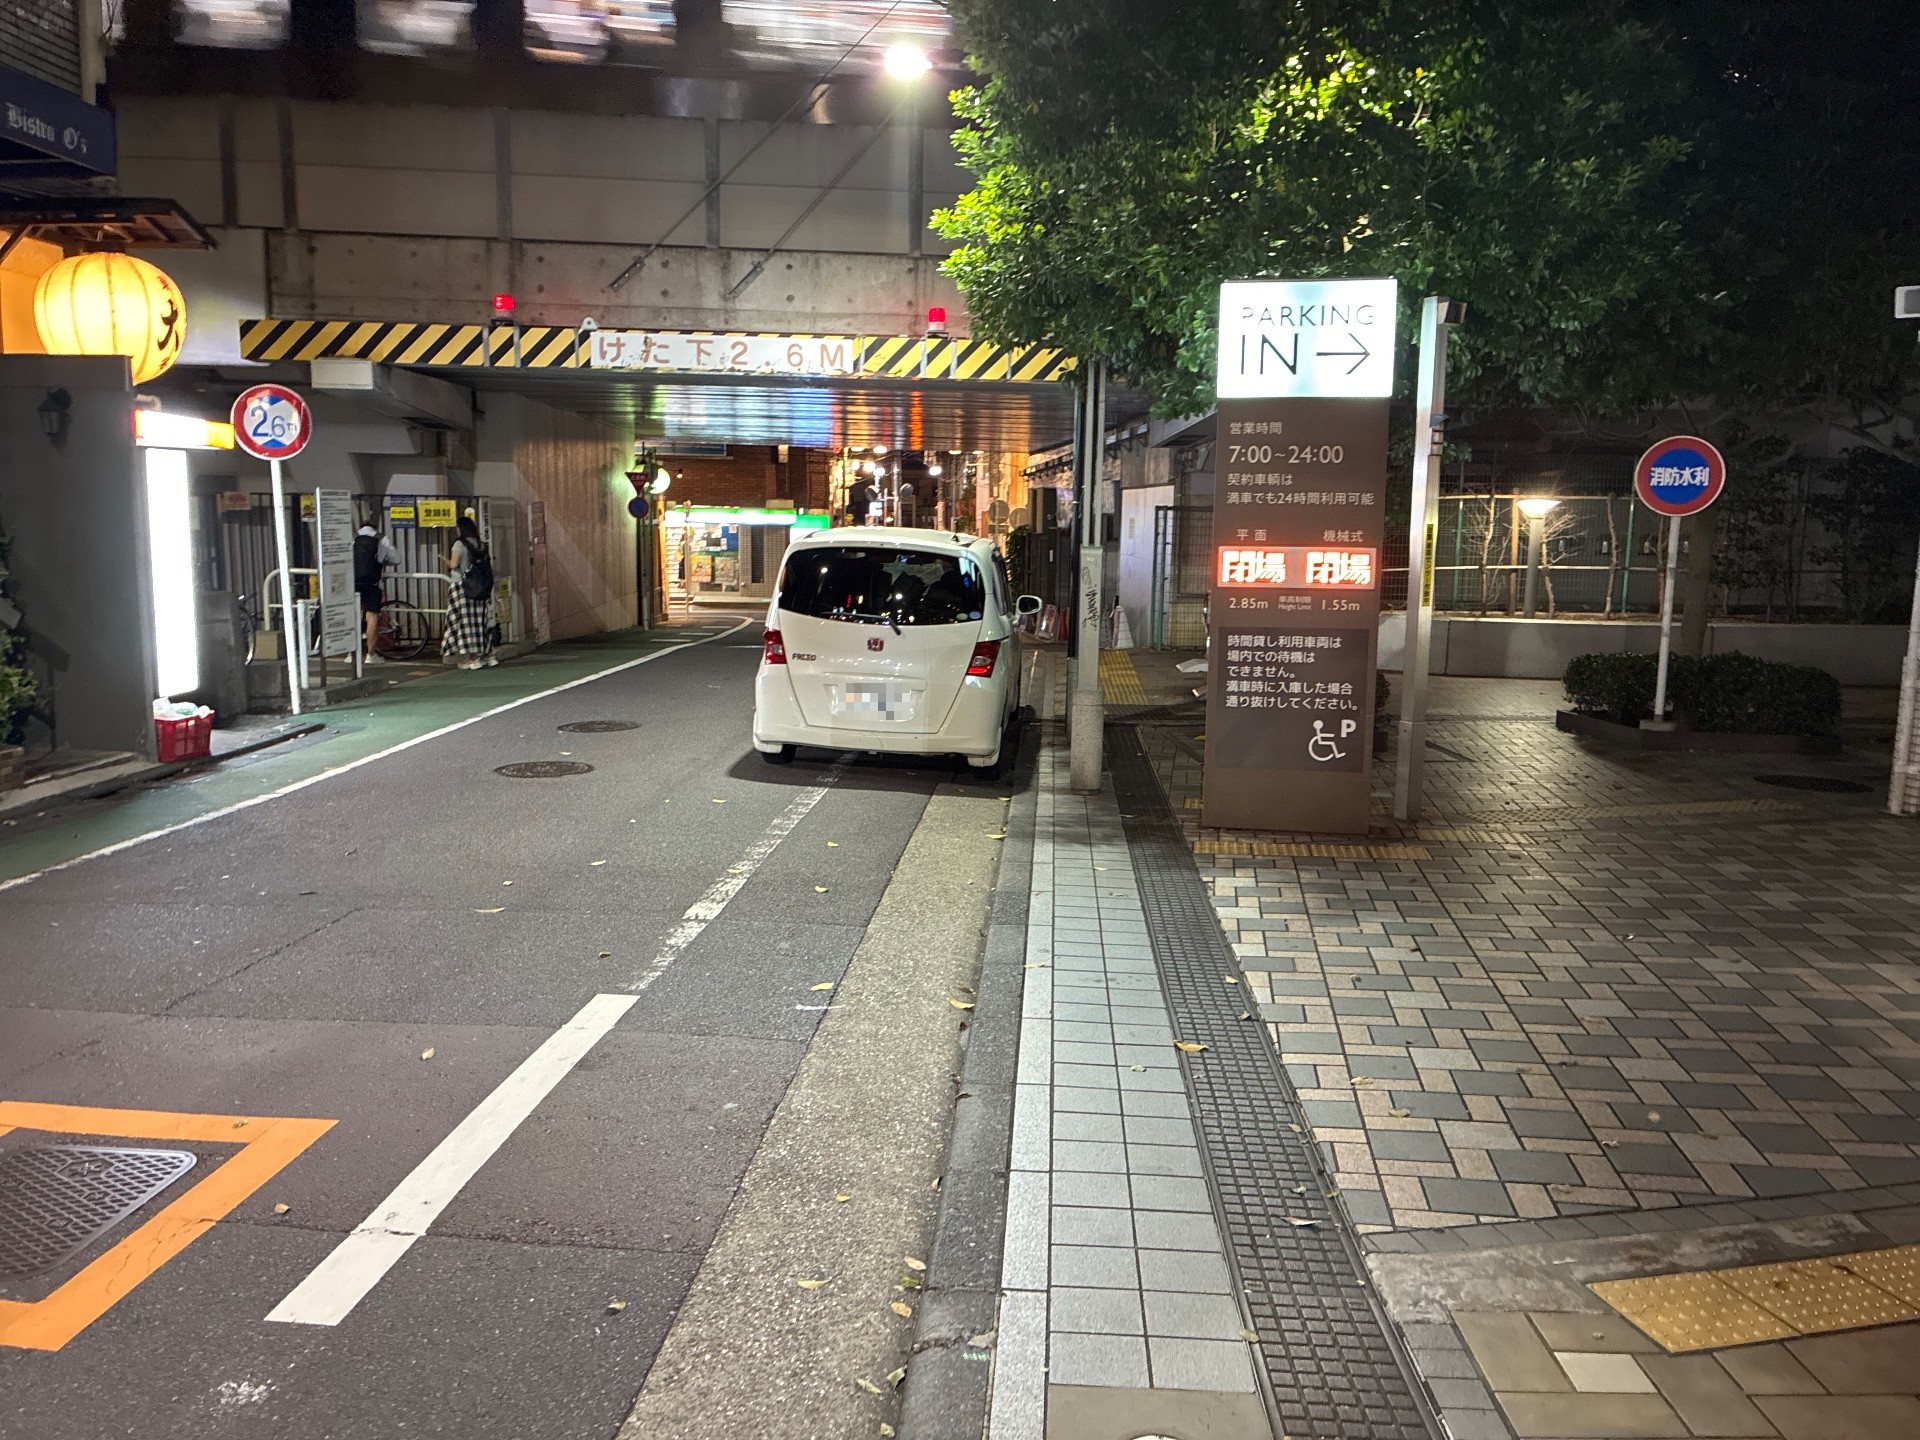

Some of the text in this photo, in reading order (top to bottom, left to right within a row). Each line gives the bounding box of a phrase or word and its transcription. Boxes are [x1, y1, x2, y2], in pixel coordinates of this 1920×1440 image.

[5, 102, 55, 142] Bistro
[1242, 305, 1374, 326] PARKING
[1241, 333, 1299, 375] IN
[1229, 421, 1283, 435] 営業時間
[1650, 466, 1710, 487] 消防水利
[1226, 491, 1375, 506] 満車でも24時間利用可能
[1323, 529, 1364, 543] 機械式
[1222, 550, 1371, 585] 閉場 閉場
[1229, 597, 1269, 609] 2.85m
[1321, 599, 1360, 611] 1.55m
[1227, 635, 1342, 649] 時間貸し利用車両は
[1226, 650, 1316, 663] 場内での待機は
[1226, 665, 1296, 679] できません。
[1225, 680, 1353, 695] 満車時に入庫した場合
[1225, 695, 1358, 711] 通り抜けしてください。
[1341, 720, 1356, 737] P
